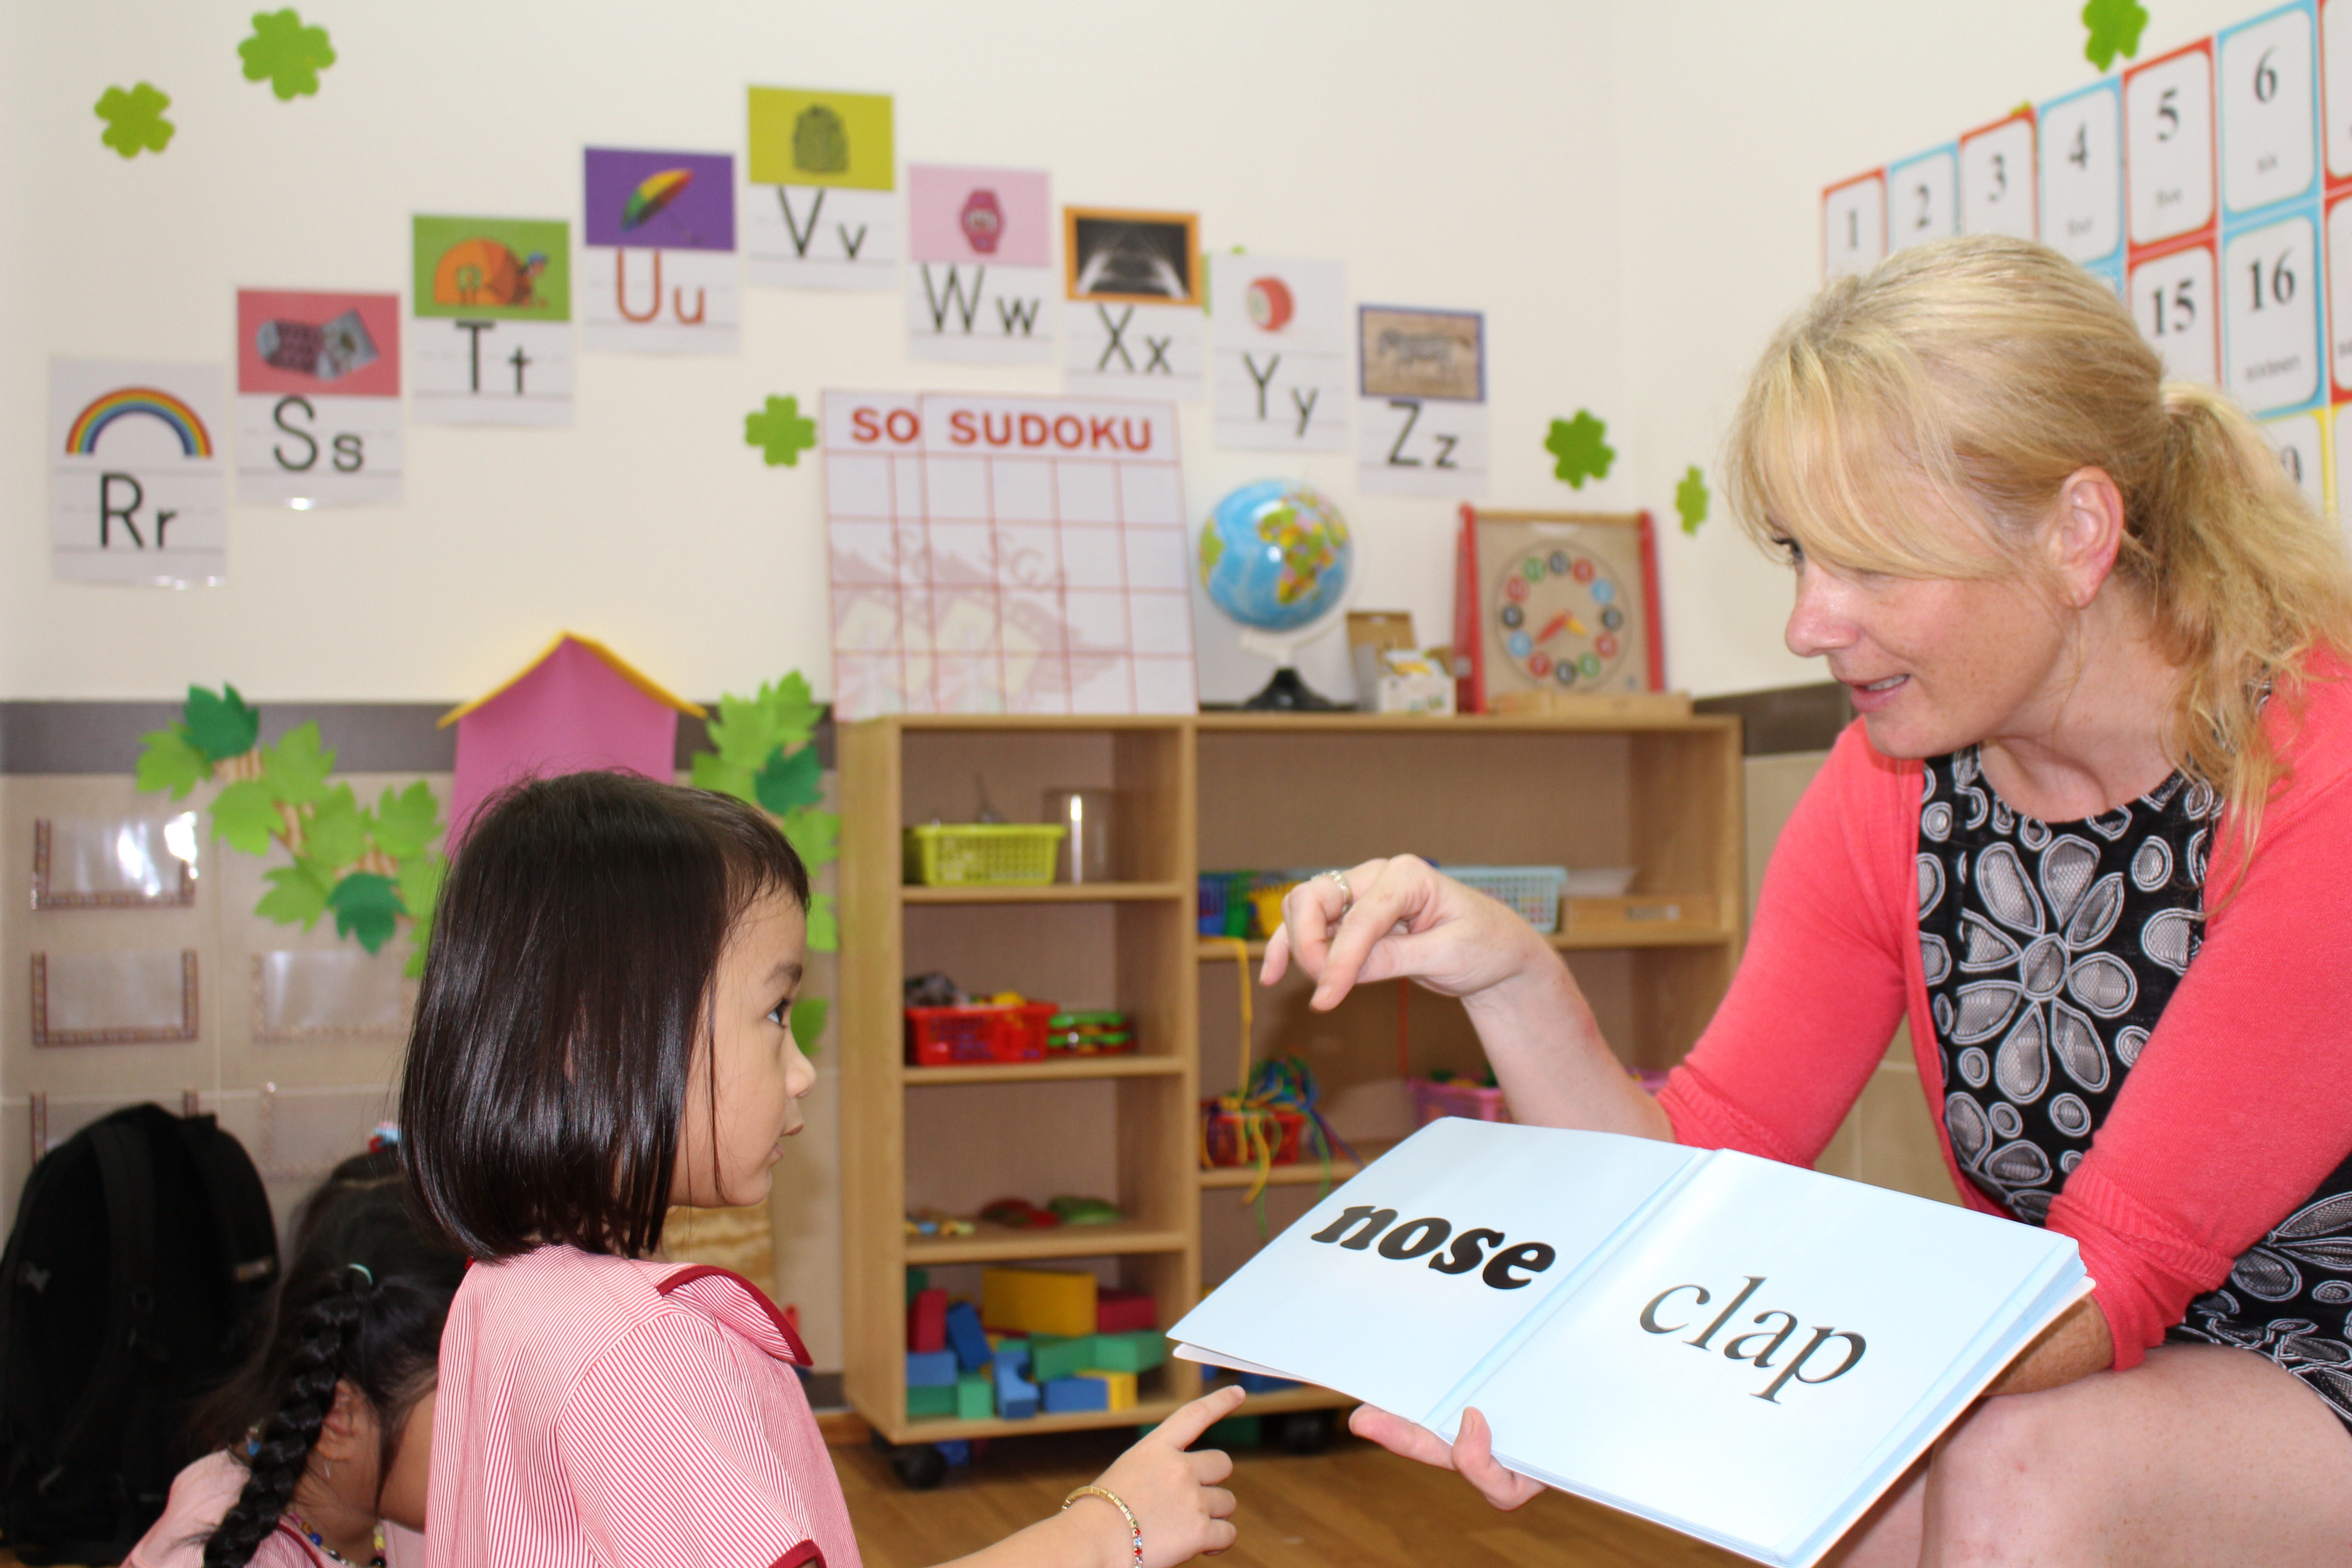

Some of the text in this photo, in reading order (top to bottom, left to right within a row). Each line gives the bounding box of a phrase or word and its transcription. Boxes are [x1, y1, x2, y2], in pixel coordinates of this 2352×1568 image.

[2253, 47, 2278, 103] 6
[2156, 87, 2180, 142] 5
[2067, 122, 2090, 171] 4
[1988, 153, 2008, 202] 3
[1846, 209, 1860, 250] 1
[1914, 184, 1931, 230] 2
[2152, 277, 2196, 337] 15
[2249, 249, 2296, 312] 16
[853, 408, 1152, 453] SO SUDOKU
[1310, 1205, 1556, 1291] nose
[1639, 1274, 1868, 1405] clap
